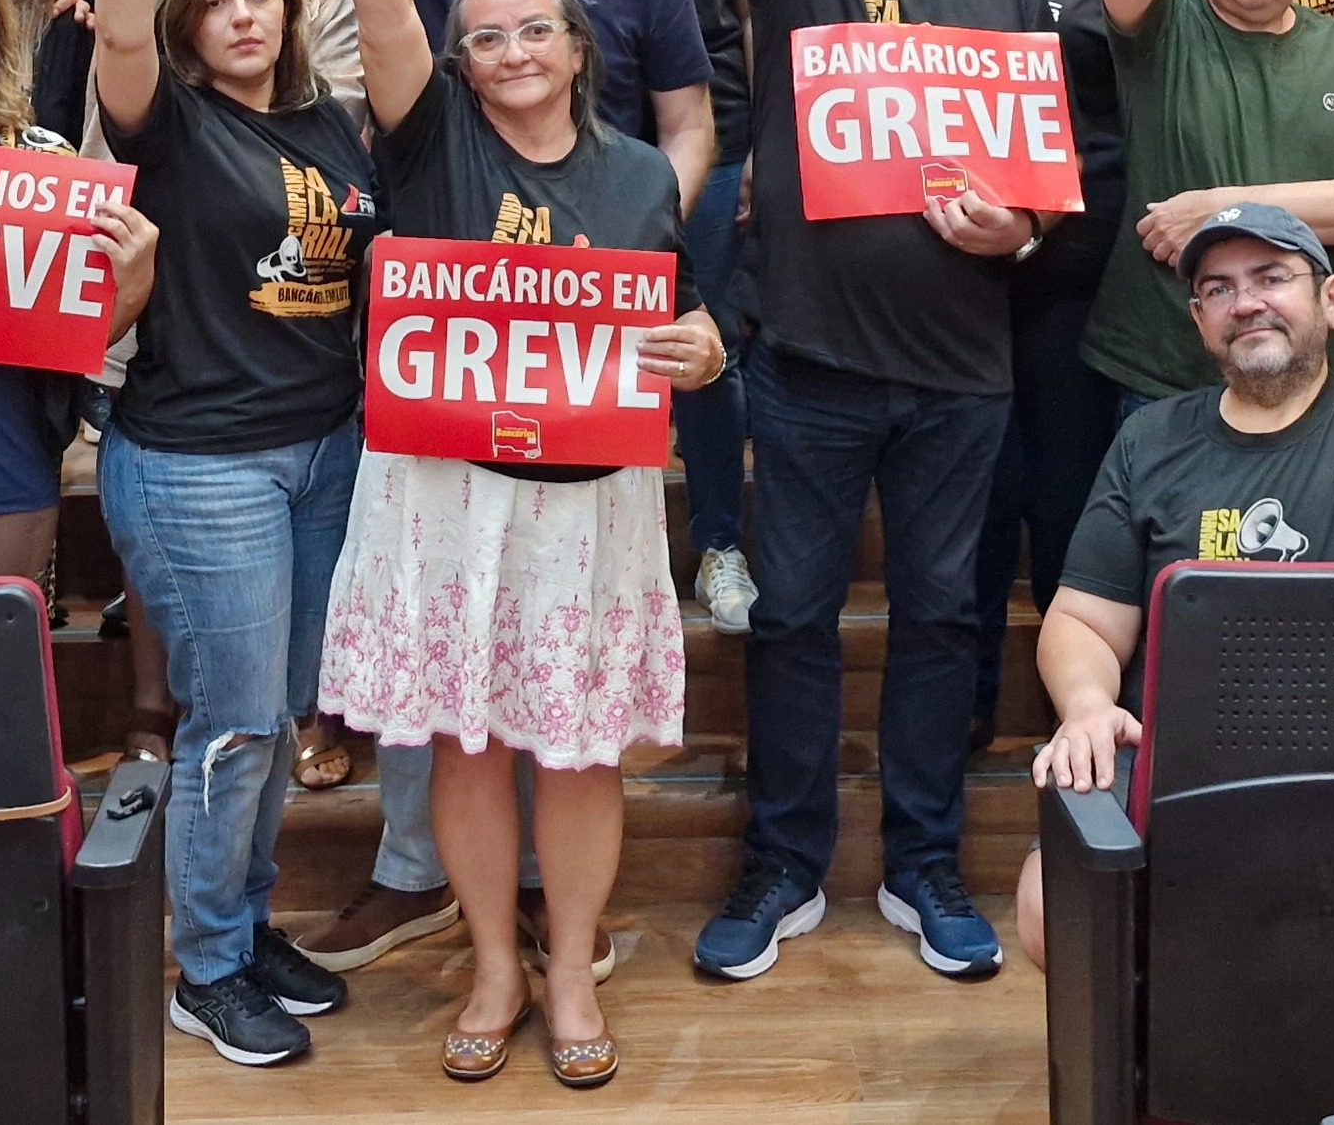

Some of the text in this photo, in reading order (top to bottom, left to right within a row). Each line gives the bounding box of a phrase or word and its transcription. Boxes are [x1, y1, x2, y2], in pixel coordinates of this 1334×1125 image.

[803, 36, 1060, 82] BANCÁRIOS EM
[807, 86, 1068, 163] GREVE
[307, 187, 339, 226] LA
[301, 224, 354, 260] RIAL
[382, 258, 603, 307] BANCÁRIOS
[612, 272, 668, 313] EM
[378, 315, 661, 410] GREVE
[1218, 508, 1240, 532] SA
[1216, 532, 1238, 557] LA
